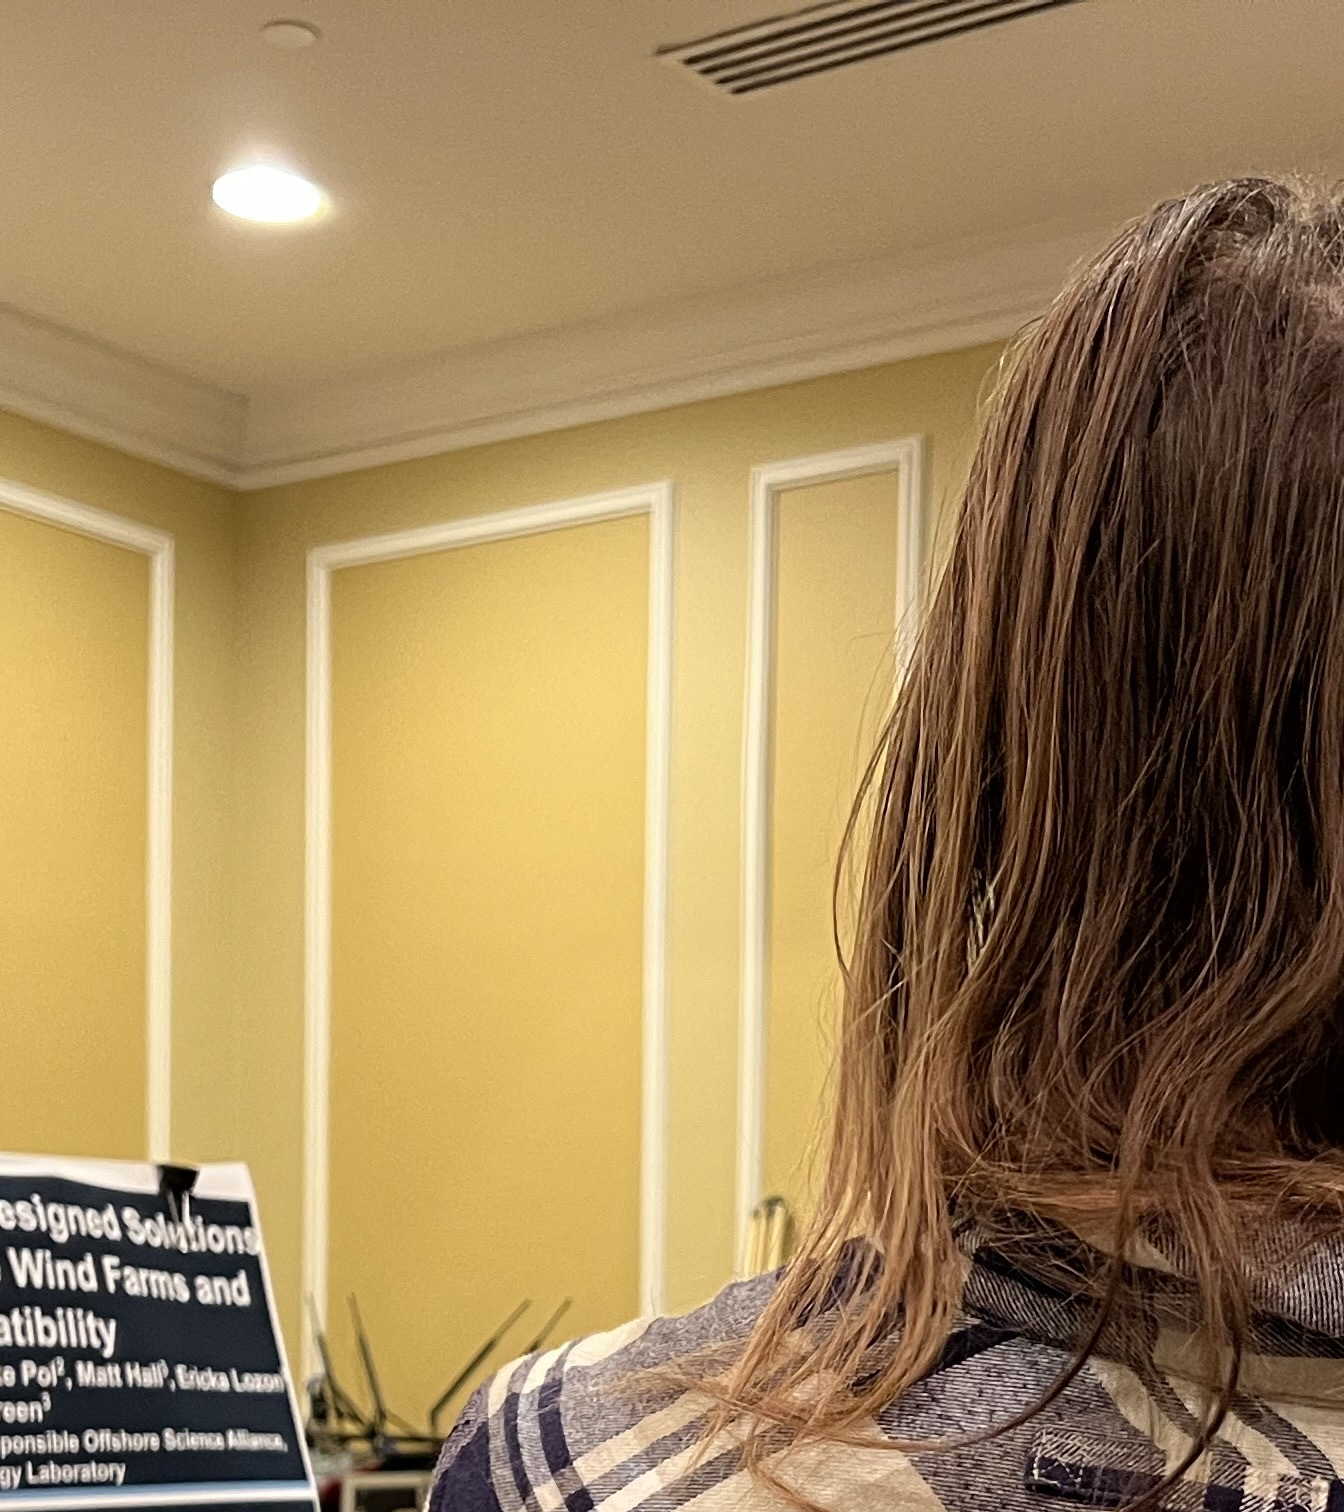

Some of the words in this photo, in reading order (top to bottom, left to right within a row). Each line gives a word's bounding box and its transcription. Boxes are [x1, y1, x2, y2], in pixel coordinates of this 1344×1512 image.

[123, 1207, 259, 1257] Solutions
[7, 1247, 98, 1292] Wind
[102, 1255, 190, 1302] Farms
[195, 1270, 251, 1306] and
[75, 1360, 123, 1387] Matt
[83, 1429, 160, 1453] Offshore
[26, 1461, 126, 1486] Laboratory
